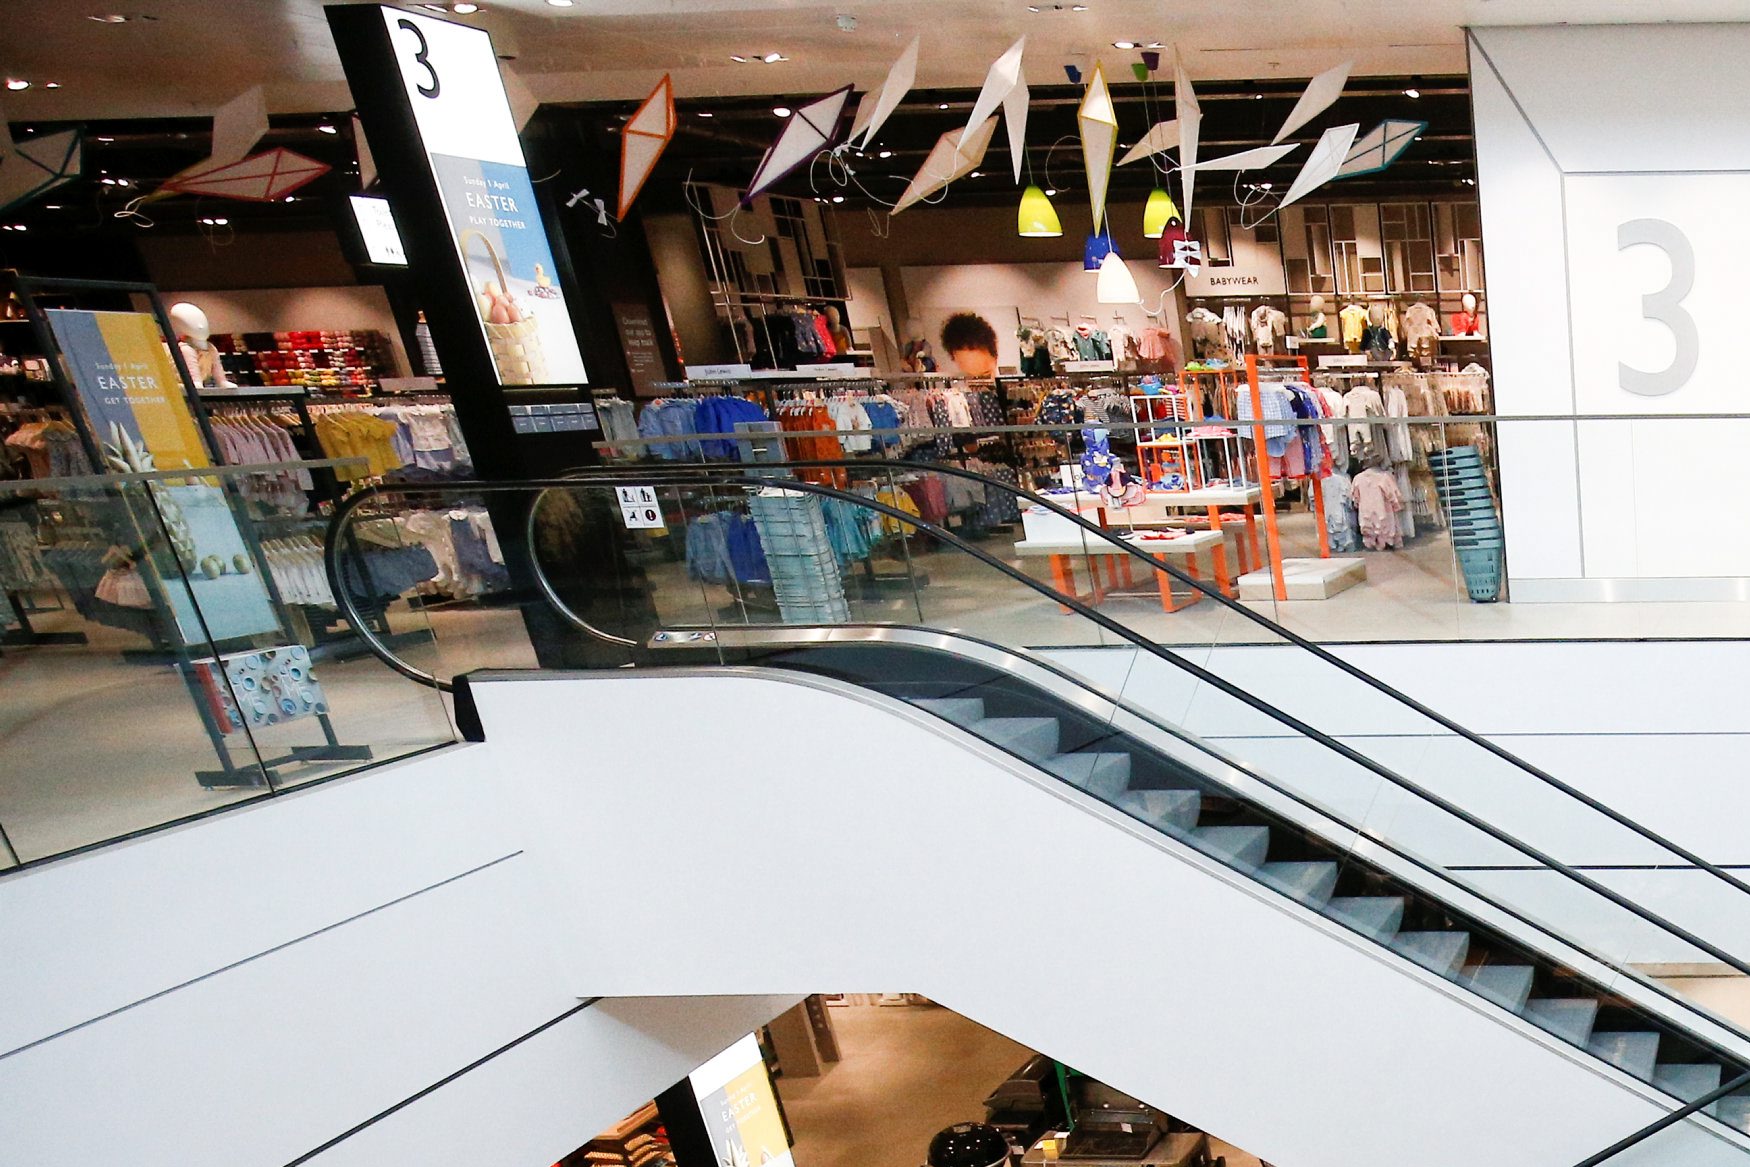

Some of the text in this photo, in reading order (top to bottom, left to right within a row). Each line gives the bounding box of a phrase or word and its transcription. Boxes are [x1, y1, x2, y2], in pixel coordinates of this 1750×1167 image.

[397, 18, 440, 99] 3
[463, 176, 487, 189] Sunday
[465, 192, 519, 213] EASTER
[469, 215, 527, 229] PLAY TOGETHER
[1209, 276, 1259, 286] BABYWEAR
[1617, 217, 1700, 397] 3
[97, 376, 159, 390] EASTER
[104, 396, 166, 405] GET TOGETHER
[721, 1092, 757, 1123] EASTER
